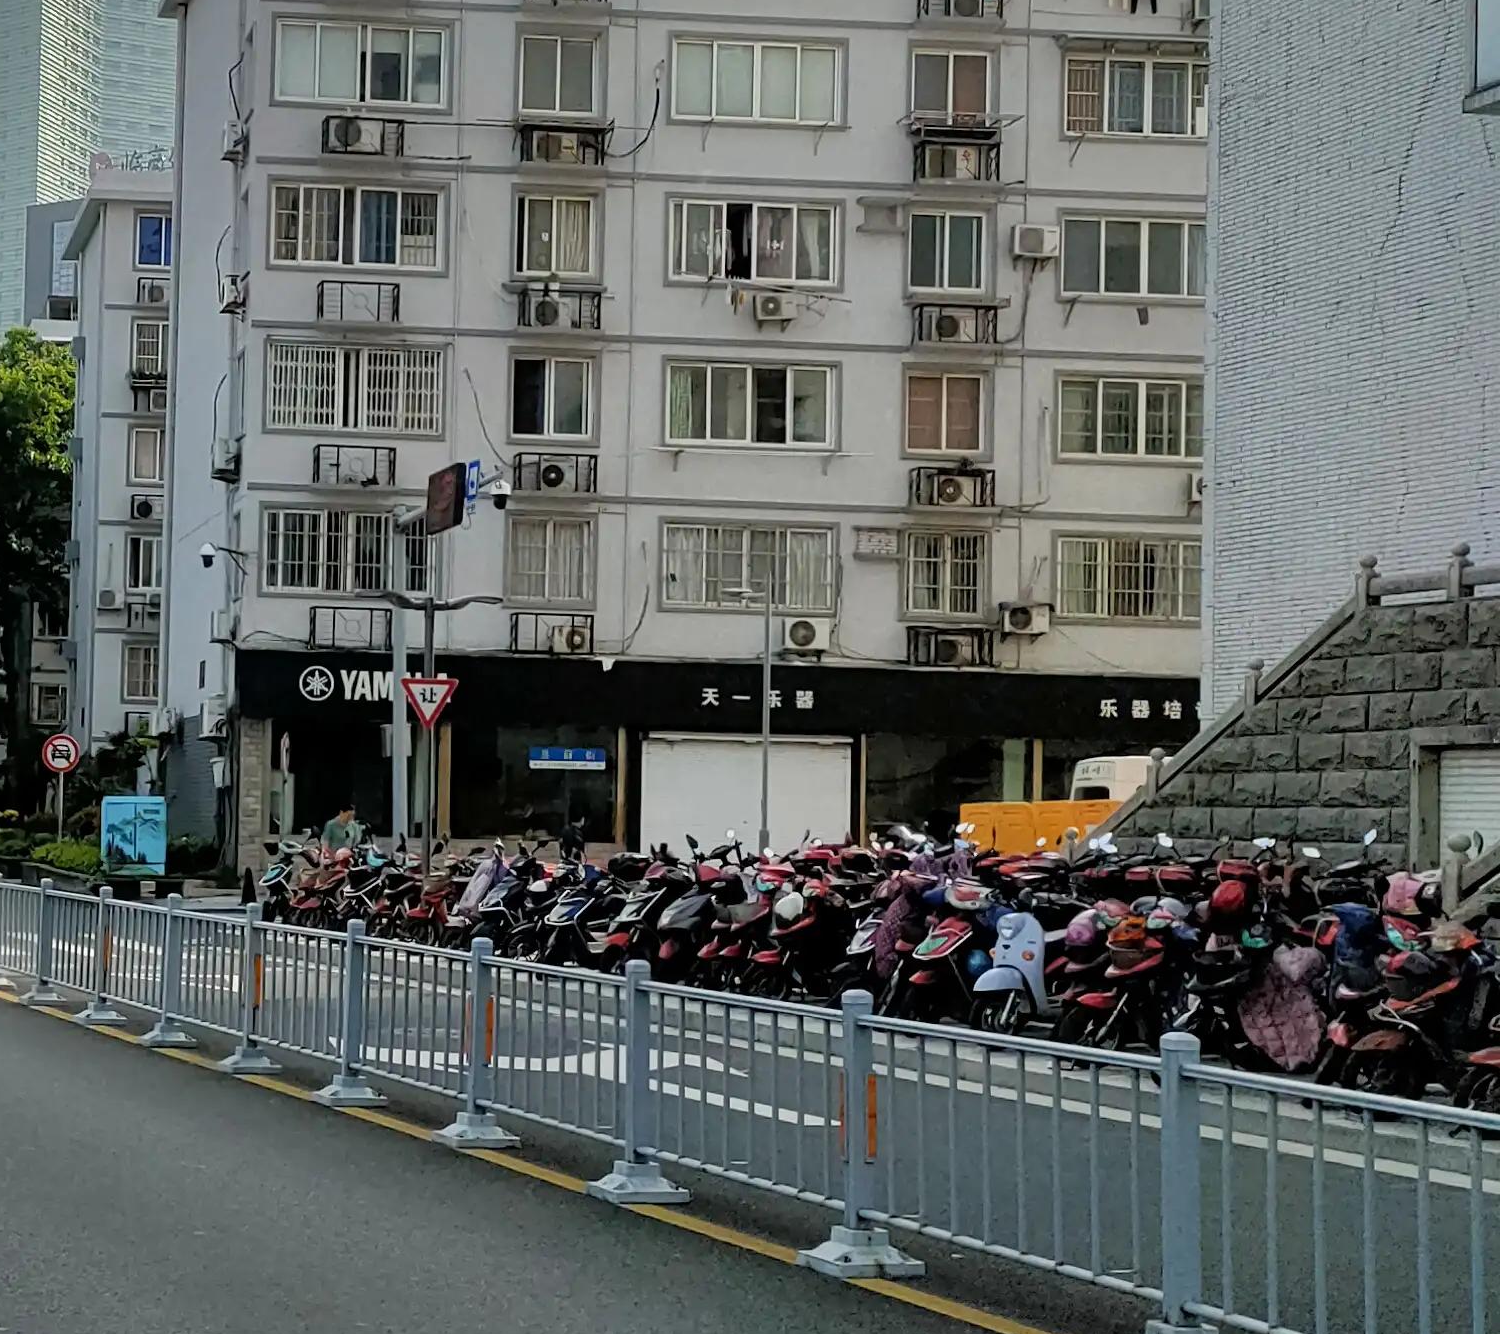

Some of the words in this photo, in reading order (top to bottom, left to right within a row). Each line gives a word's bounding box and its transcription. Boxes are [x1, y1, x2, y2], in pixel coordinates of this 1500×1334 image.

[340, 669, 452, 703] YAM
[420, 687, 437, 704] 让
[701, 688, 814, 709] 天一乐器
[1100, 699, 1200, 720] 乐器培
